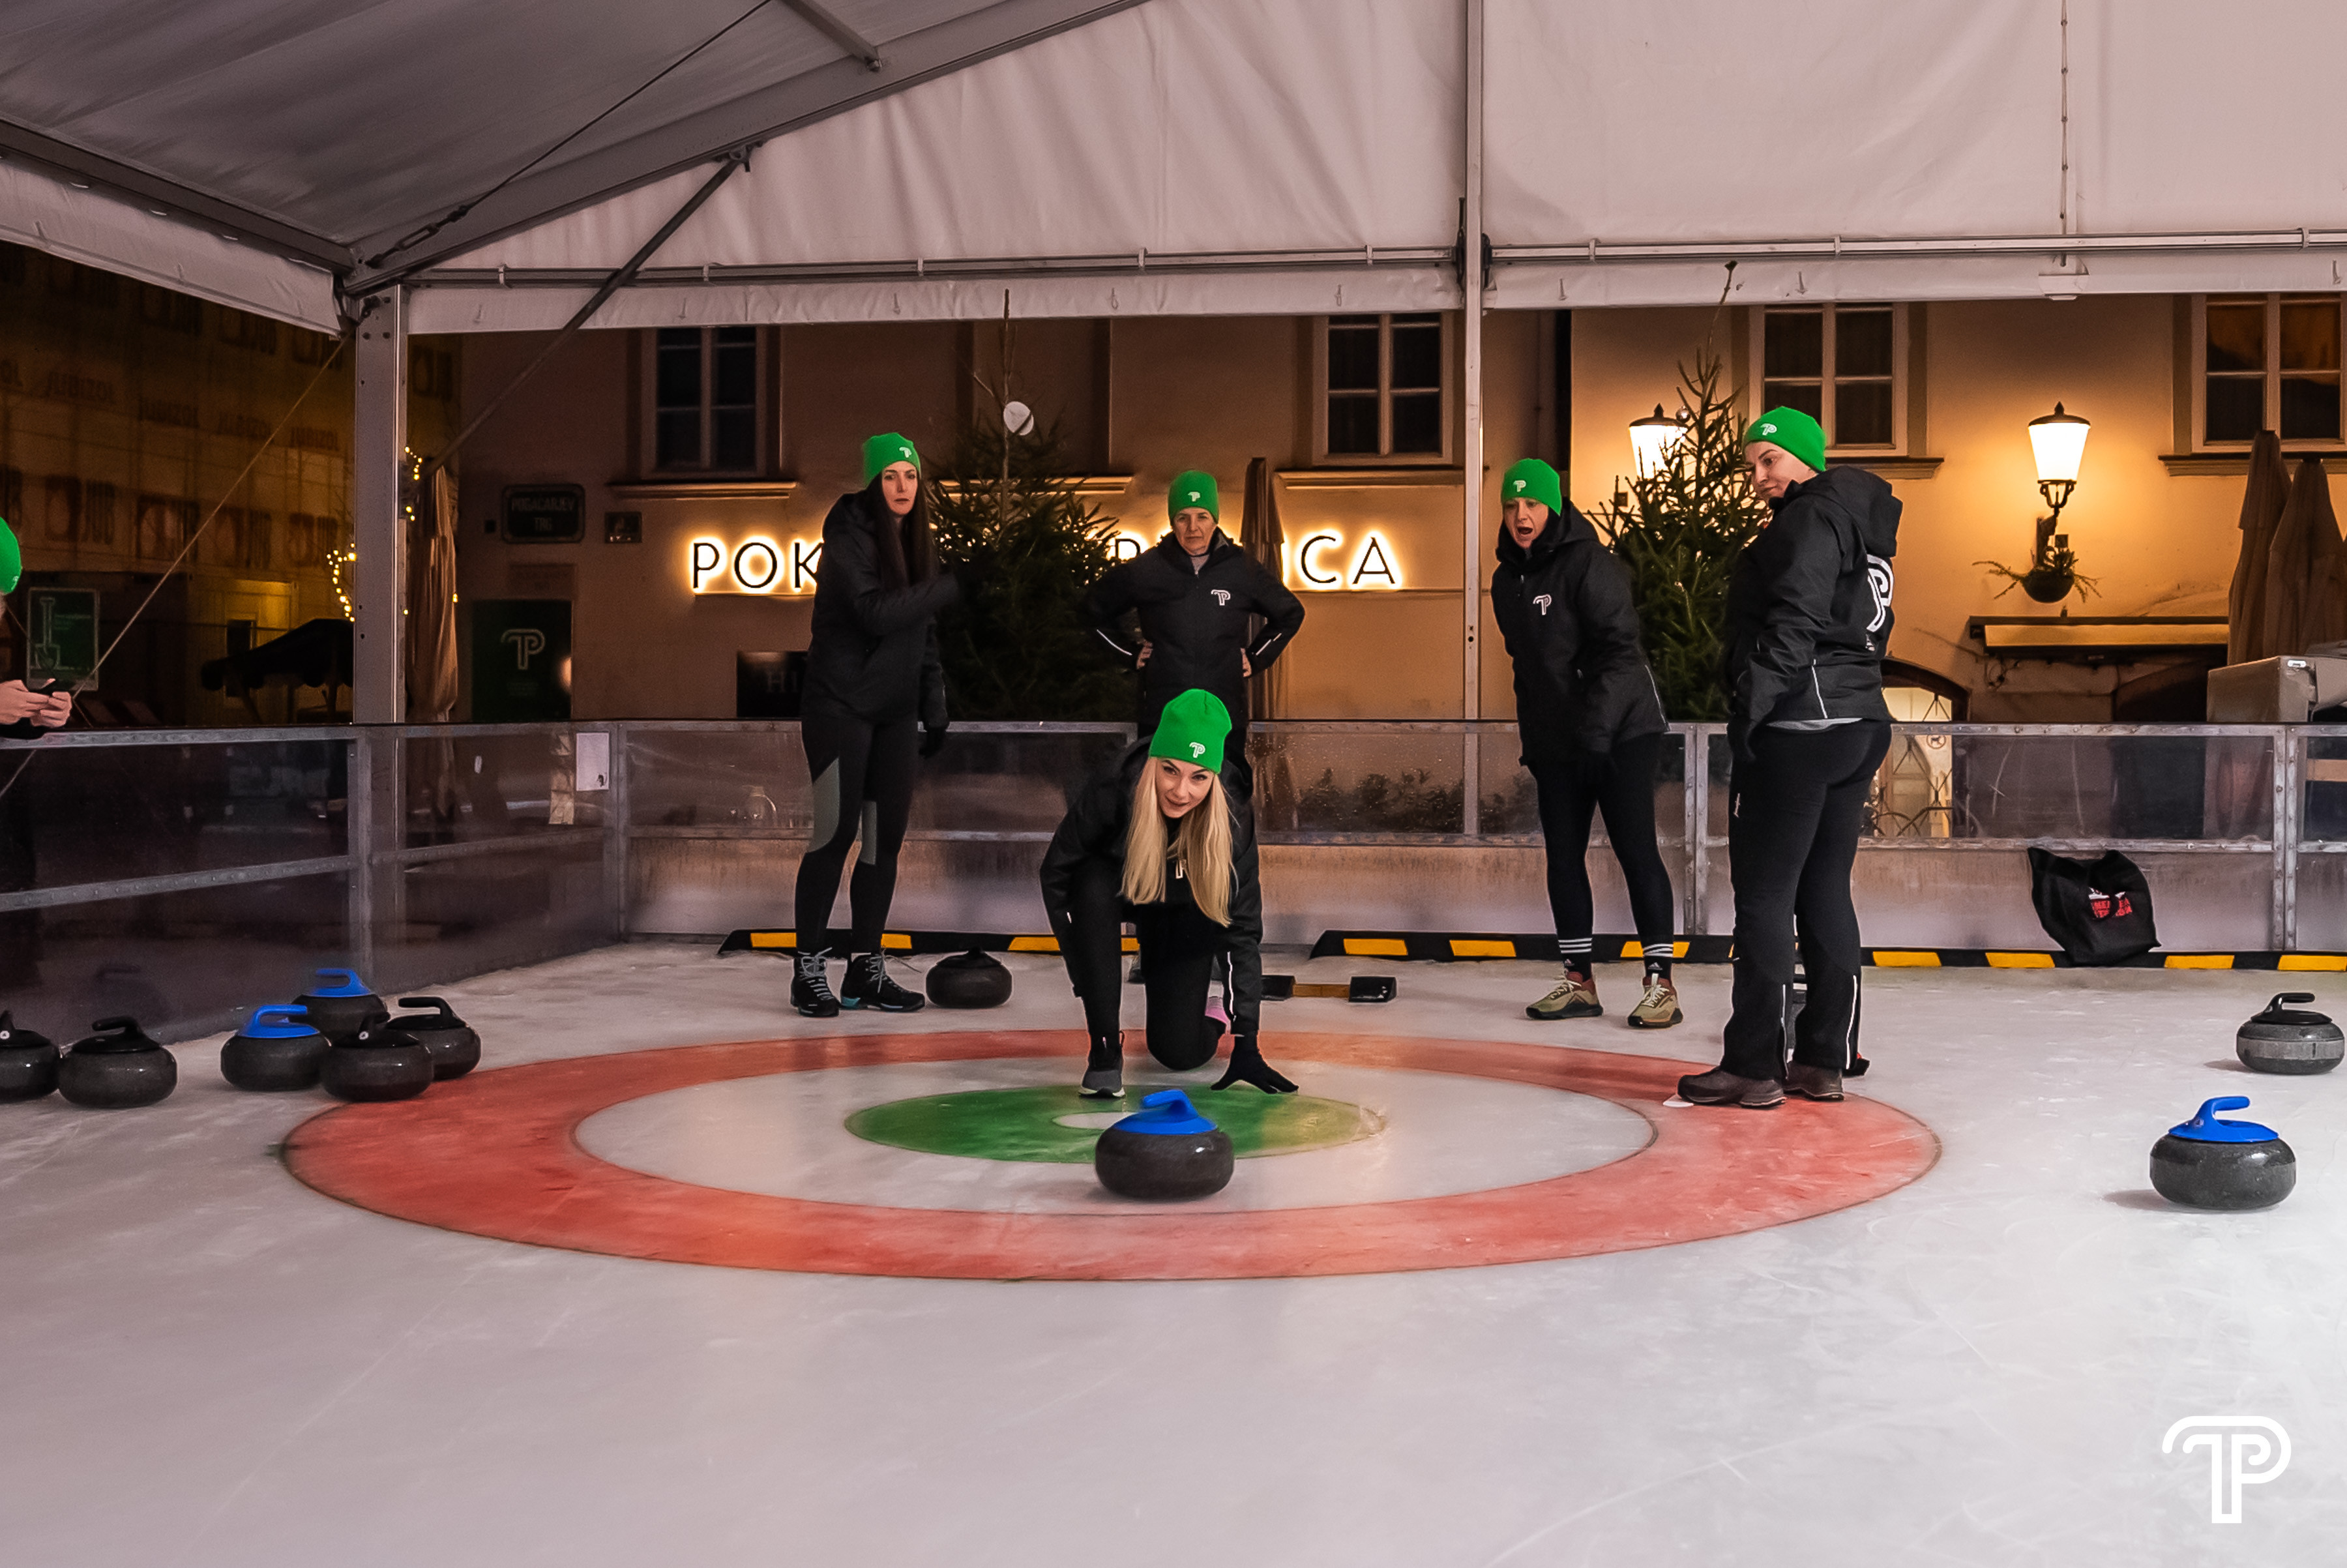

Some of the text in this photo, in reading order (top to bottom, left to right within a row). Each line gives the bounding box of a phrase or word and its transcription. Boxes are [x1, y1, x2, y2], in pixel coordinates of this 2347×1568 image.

[534, 516, 553, 532] TRG
[693, 542, 825, 589] POK
[765, 670, 799, 694] HI
